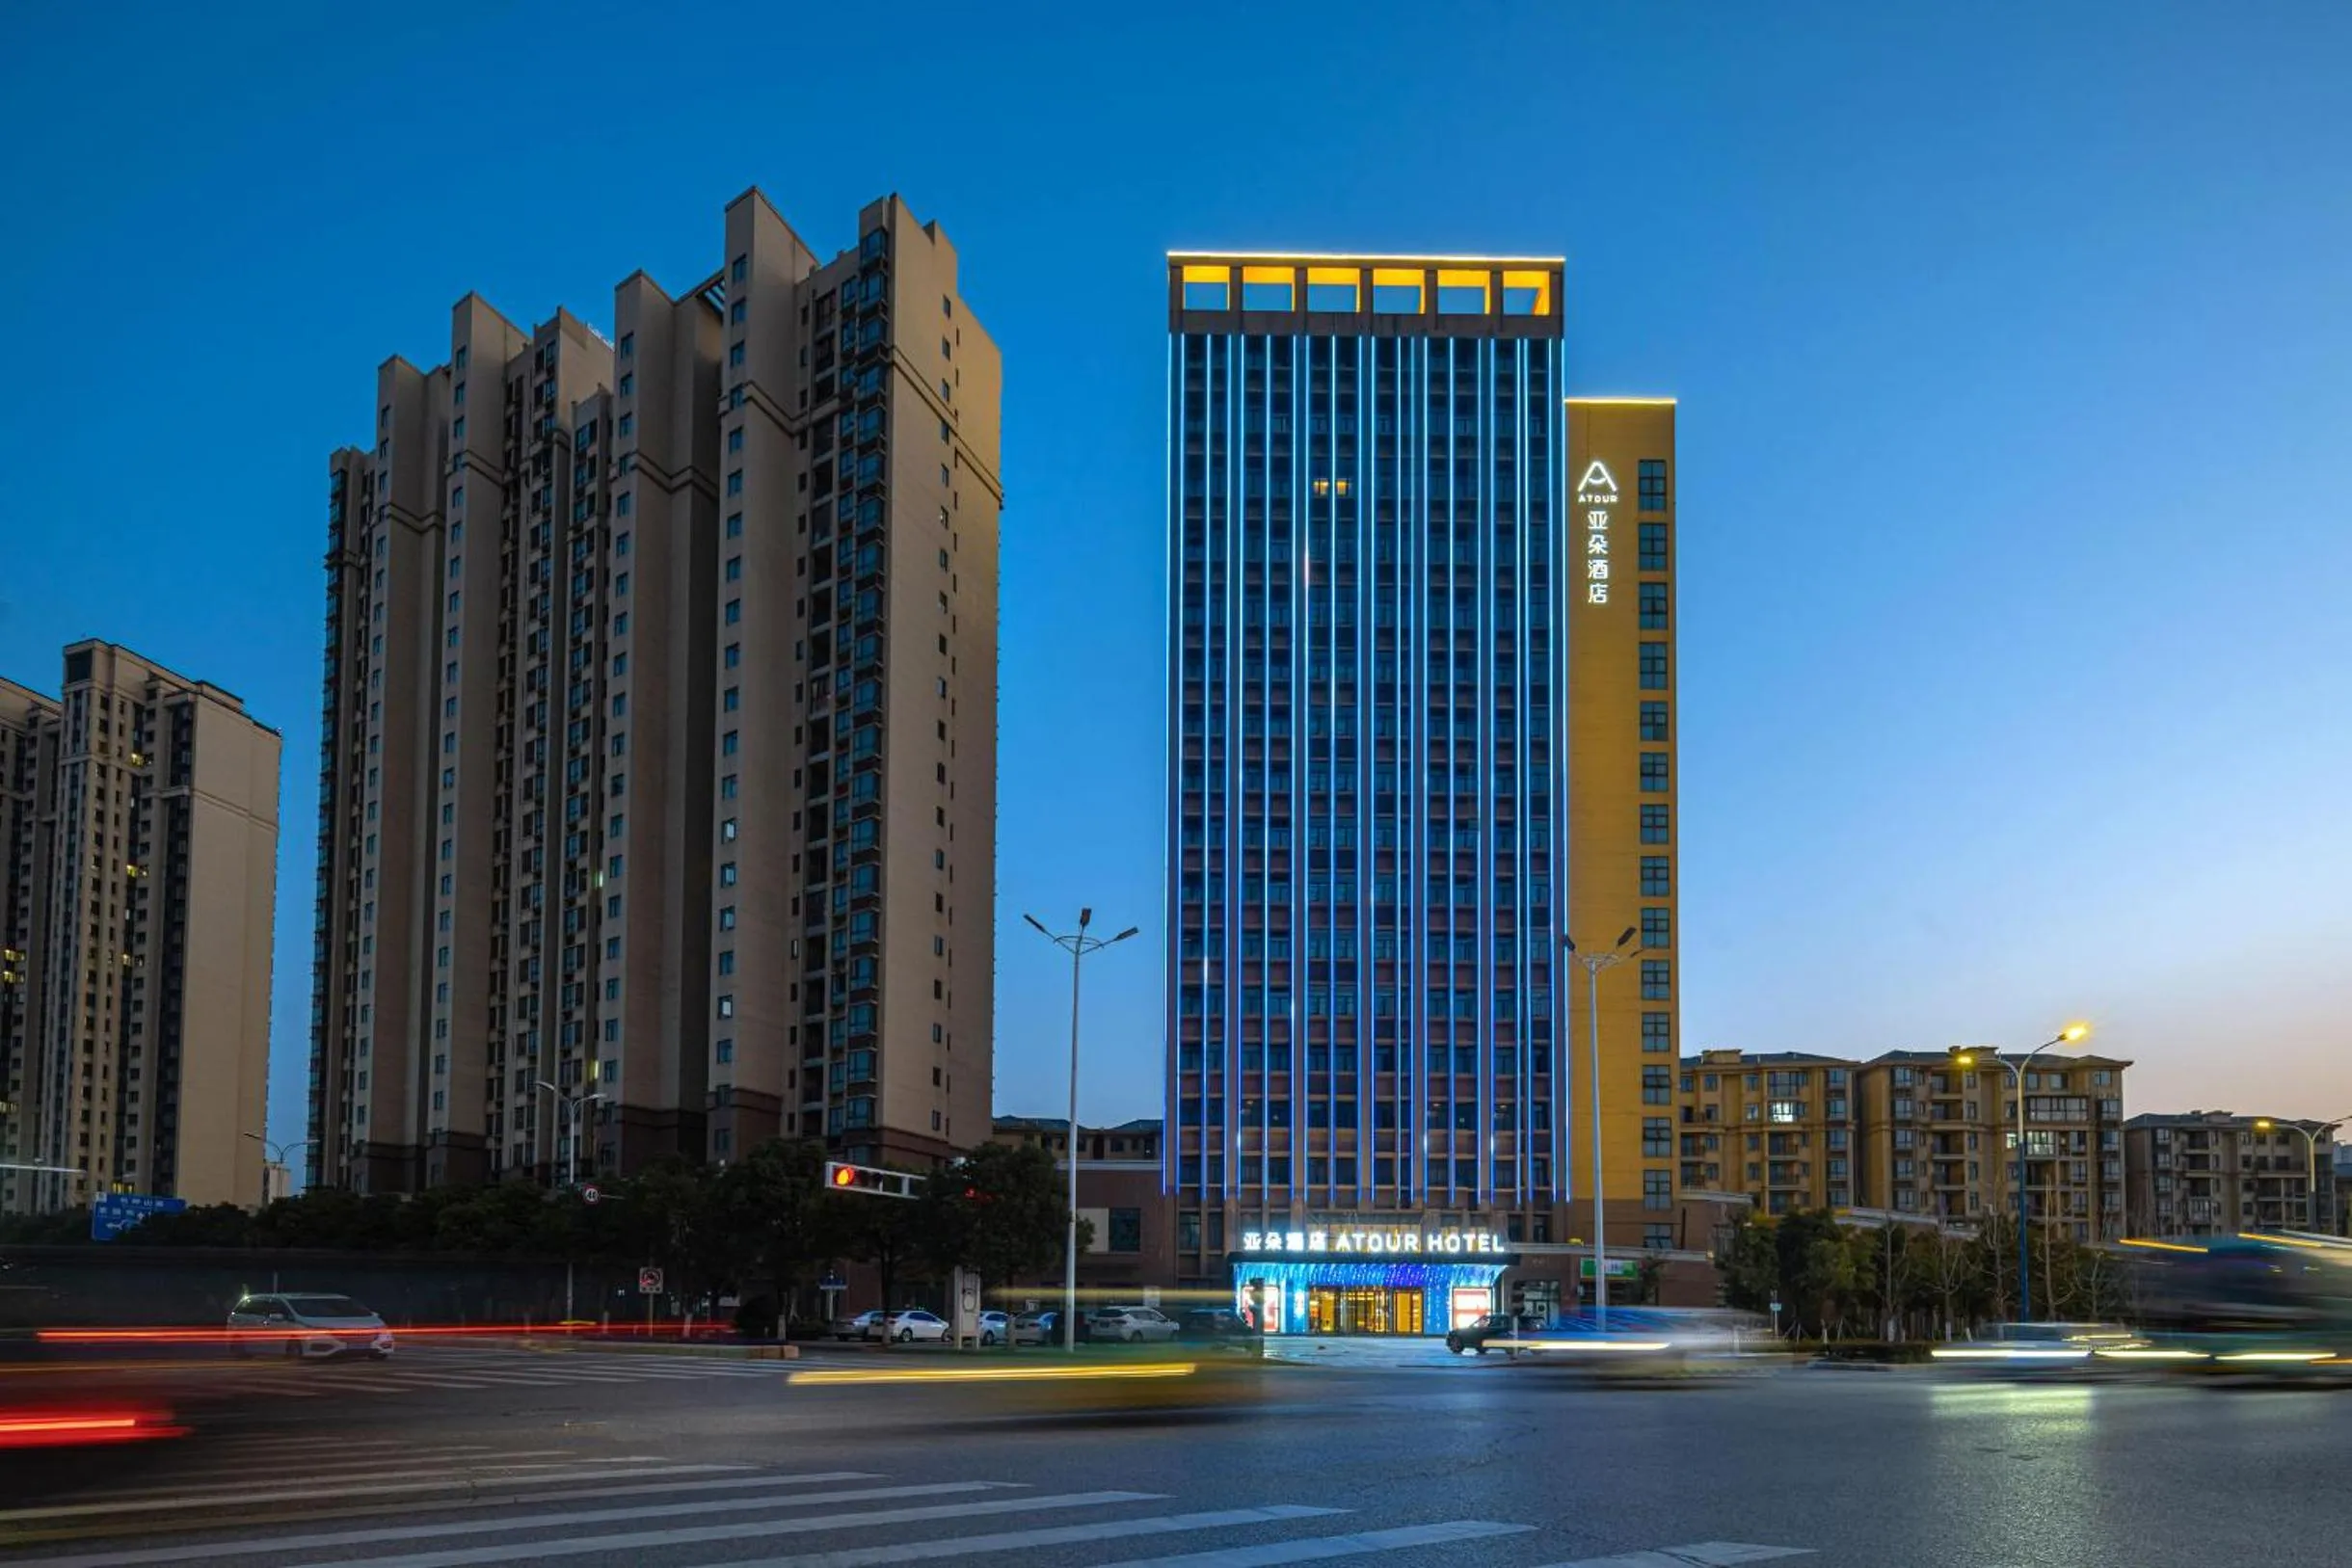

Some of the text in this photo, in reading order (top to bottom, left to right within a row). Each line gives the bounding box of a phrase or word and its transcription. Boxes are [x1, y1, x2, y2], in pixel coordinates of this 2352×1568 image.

[1578, 494, 1618, 503] ATOUR
[1588, 511, 1609, 603] 亚朵酒店
[1335, 1233, 1419, 1252] ATOUR
[1428, 1233, 1505, 1252] HOTEL
